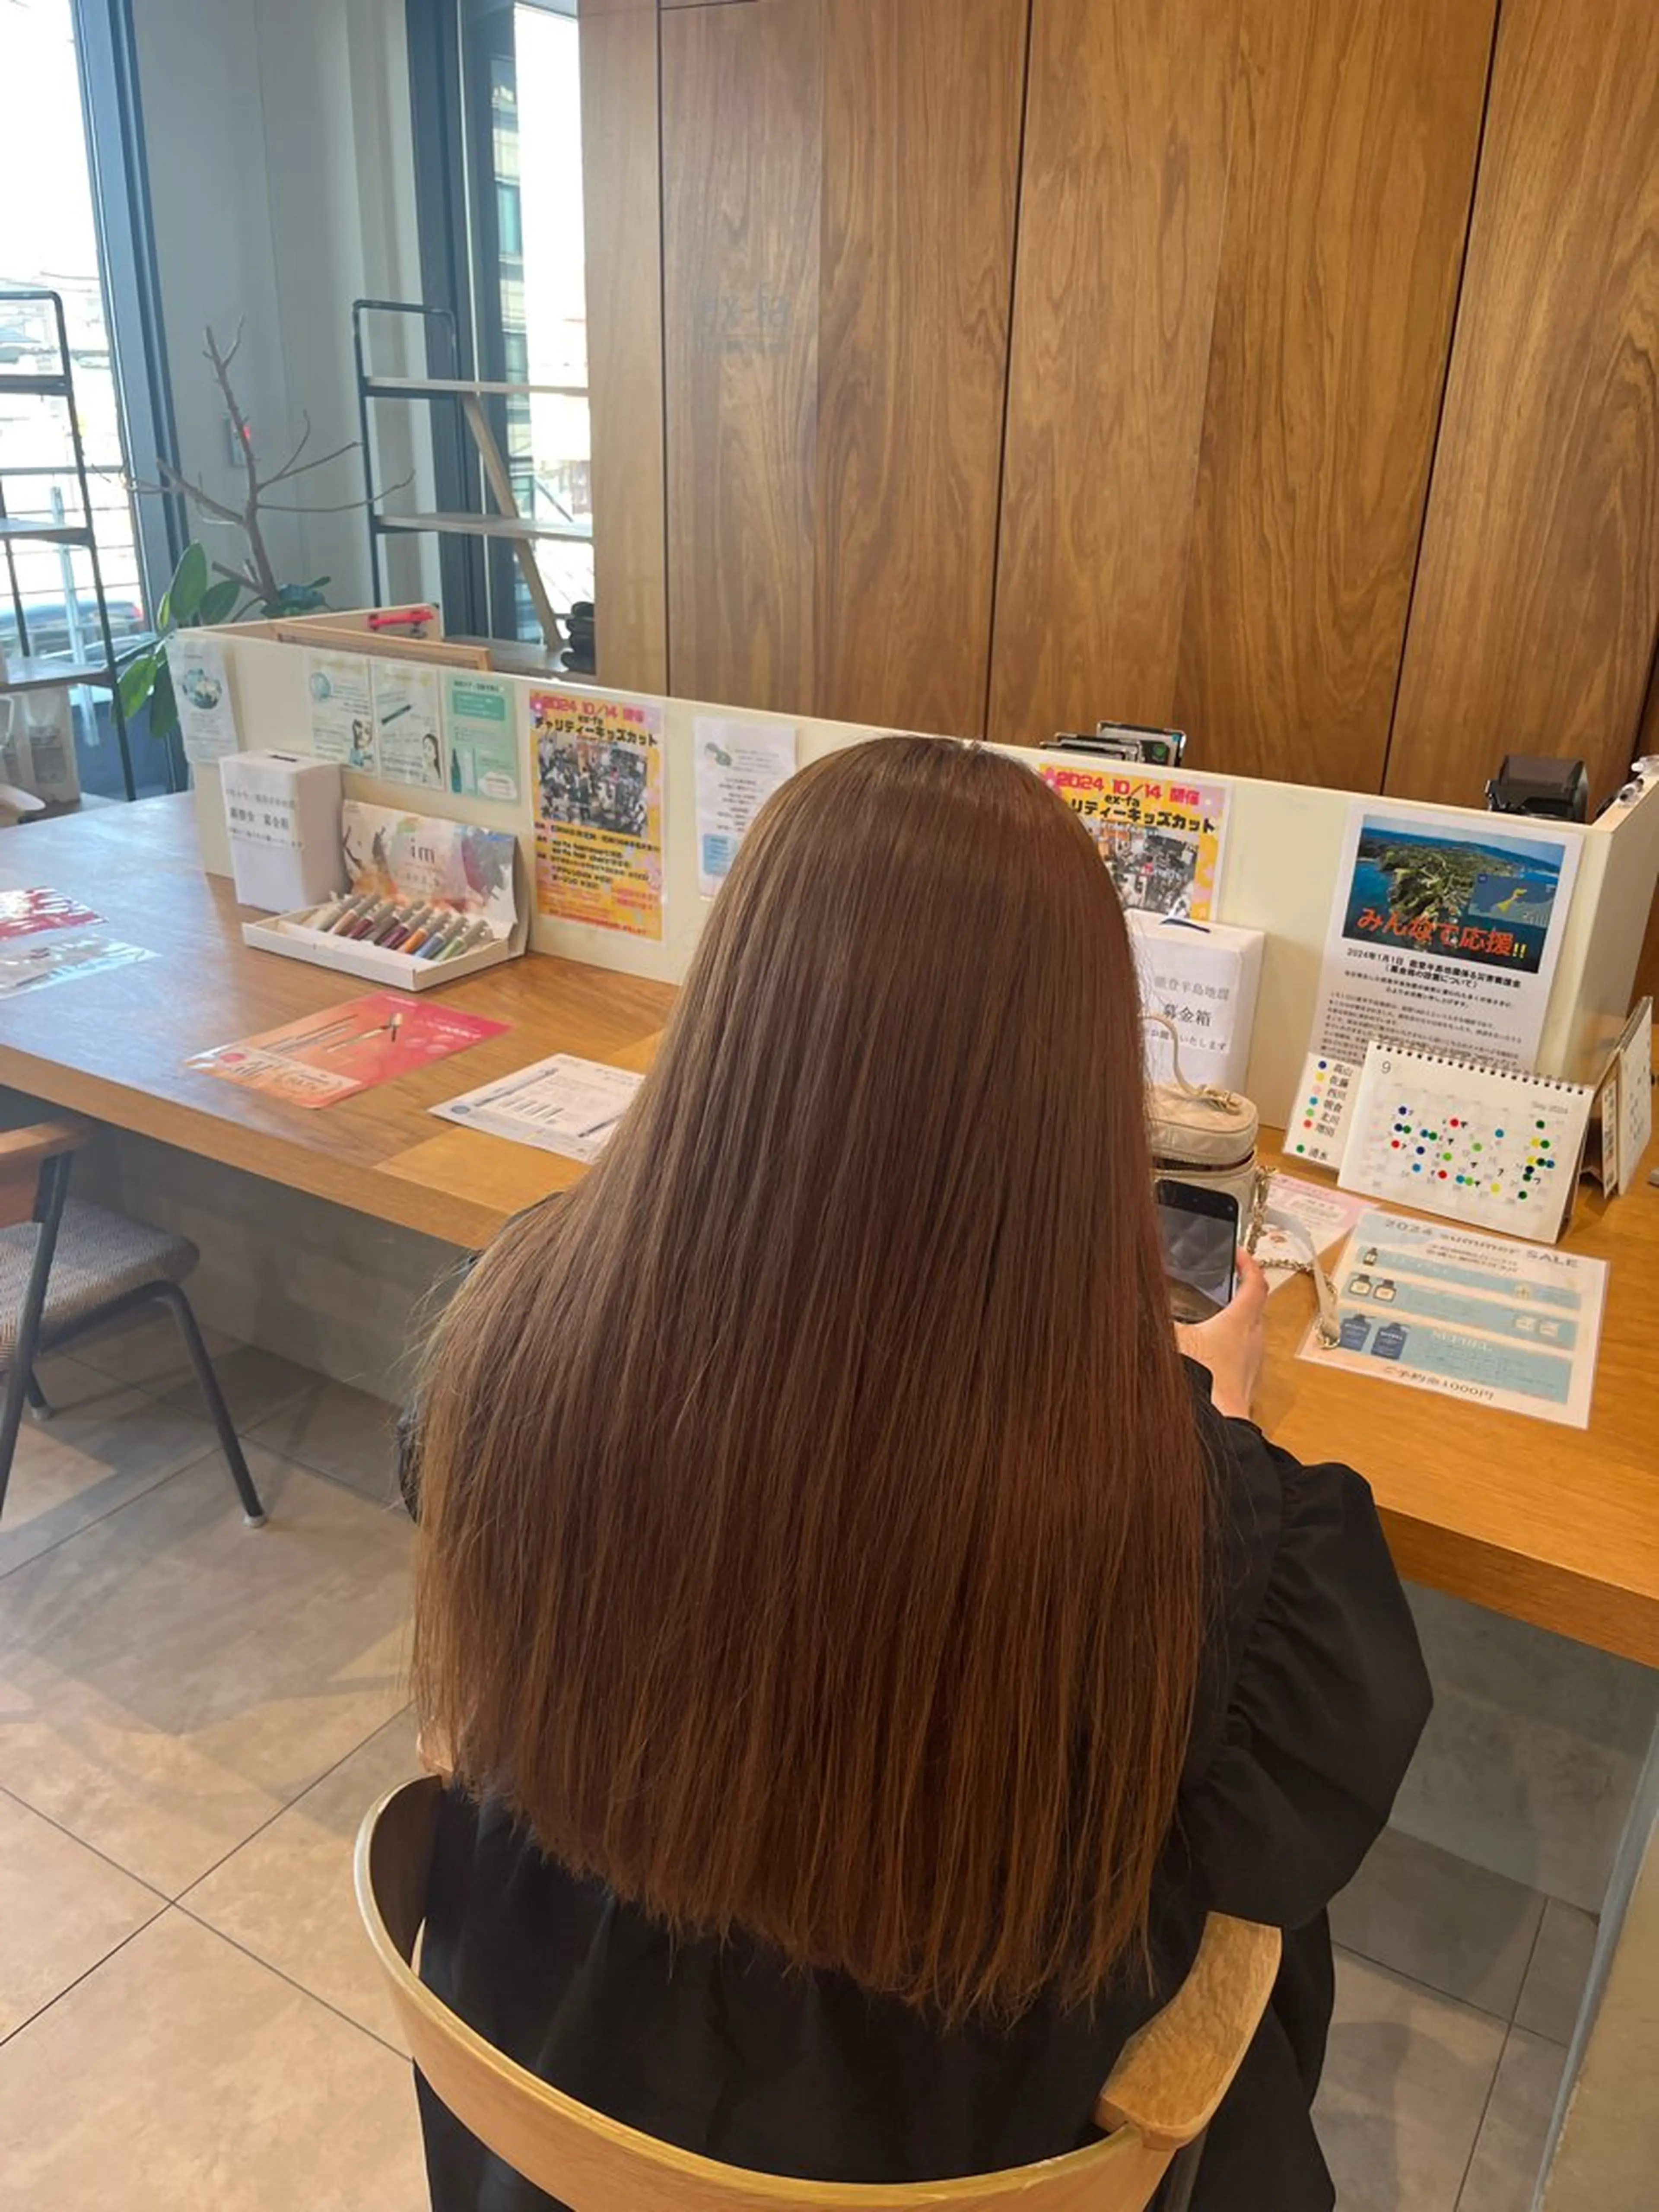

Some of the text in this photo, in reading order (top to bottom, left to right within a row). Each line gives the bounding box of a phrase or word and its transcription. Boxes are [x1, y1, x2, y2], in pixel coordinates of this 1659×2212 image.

[1057, 771, 1200, 806] 2024 10/14 開催
[1104, 794, 1140, 807] ex-fa
[1382, 1060, 1392, 1074] 9
[1385, 1218, 1433, 1236] 2024
[1440, 1233, 1521, 1254] summer
[1526, 1249, 1580, 1269] SALE
